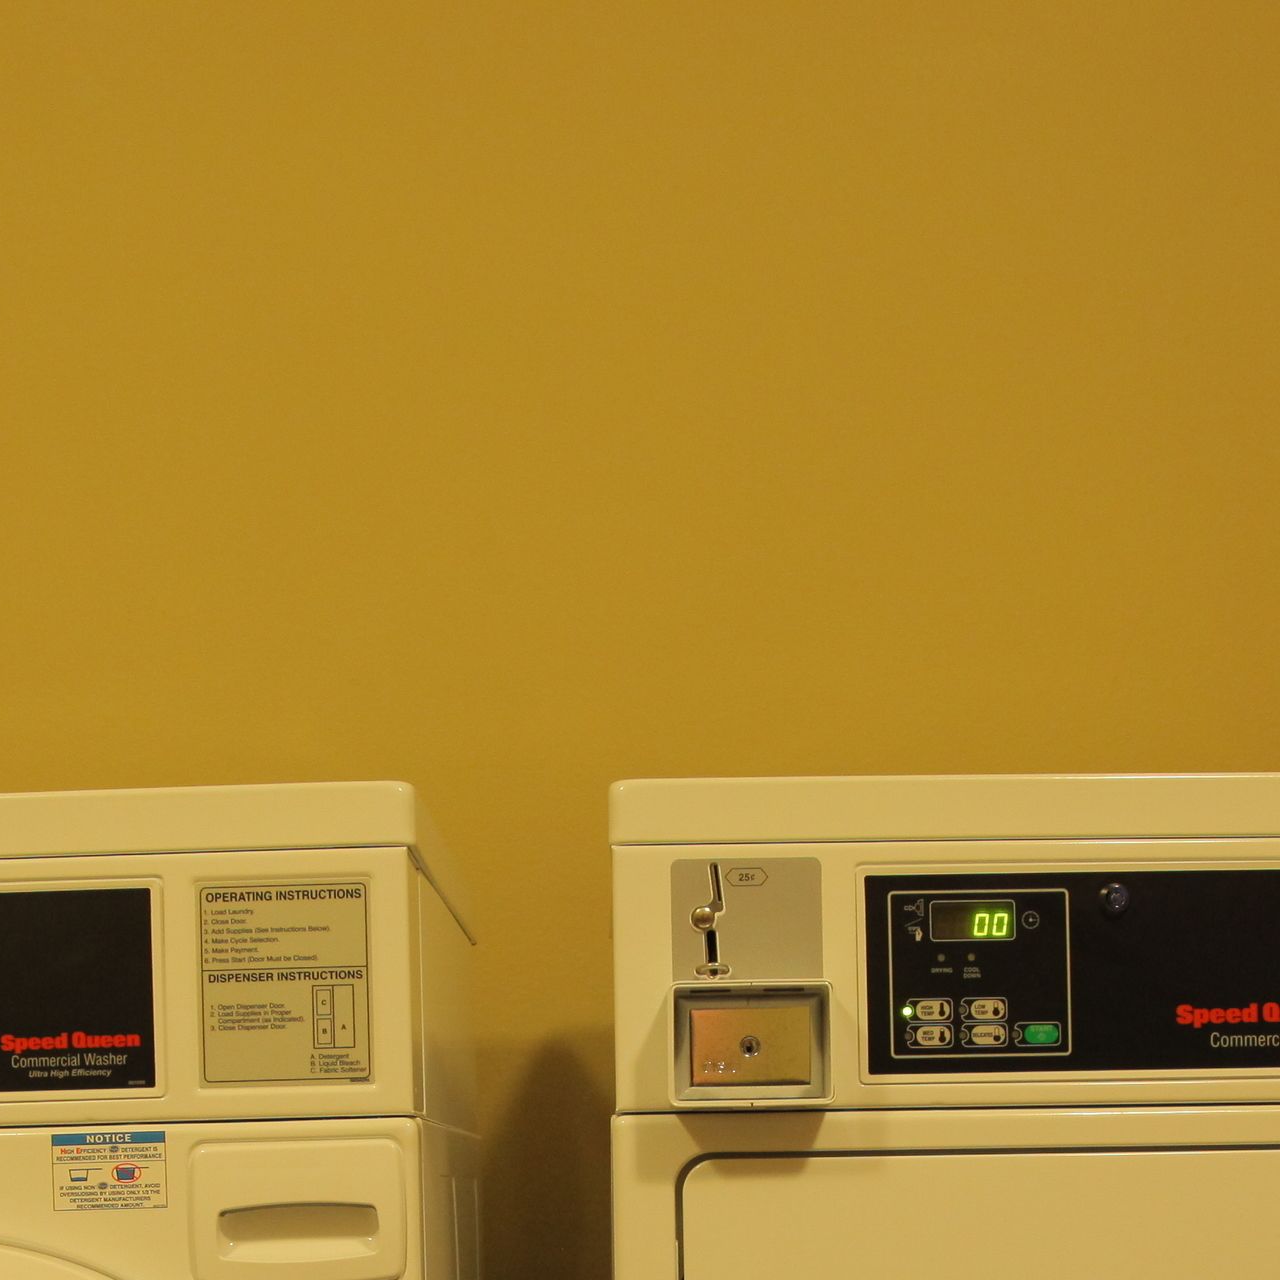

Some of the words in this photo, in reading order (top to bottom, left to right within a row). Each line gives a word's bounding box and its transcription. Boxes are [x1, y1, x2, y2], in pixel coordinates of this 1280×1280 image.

[739, 873, 755, 882] 25¢
[206, 891, 272, 903] OPERATING
[276, 889, 361, 900] INSTRUCTIONS
[973, 913, 1008, 936] 00
[208, 972, 273, 983] DISPENSER
[277, 970, 363, 981] INSTRUCTIONS
[1176, 1003, 1258, 1028] Speed
[1, 1032, 68, 1053] Speed
[72, 1031, 140, 1048] Queen
[12, 1053, 80, 1068] Commercial
[84, 1053, 128, 1065] Washer
[29, 1070, 48, 1078] Ultra
[50, 1070, 69, 1078] High
[71, 1068, 111, 1077] Efficiency
[86, 1134, 132, 1143] NOTICE
